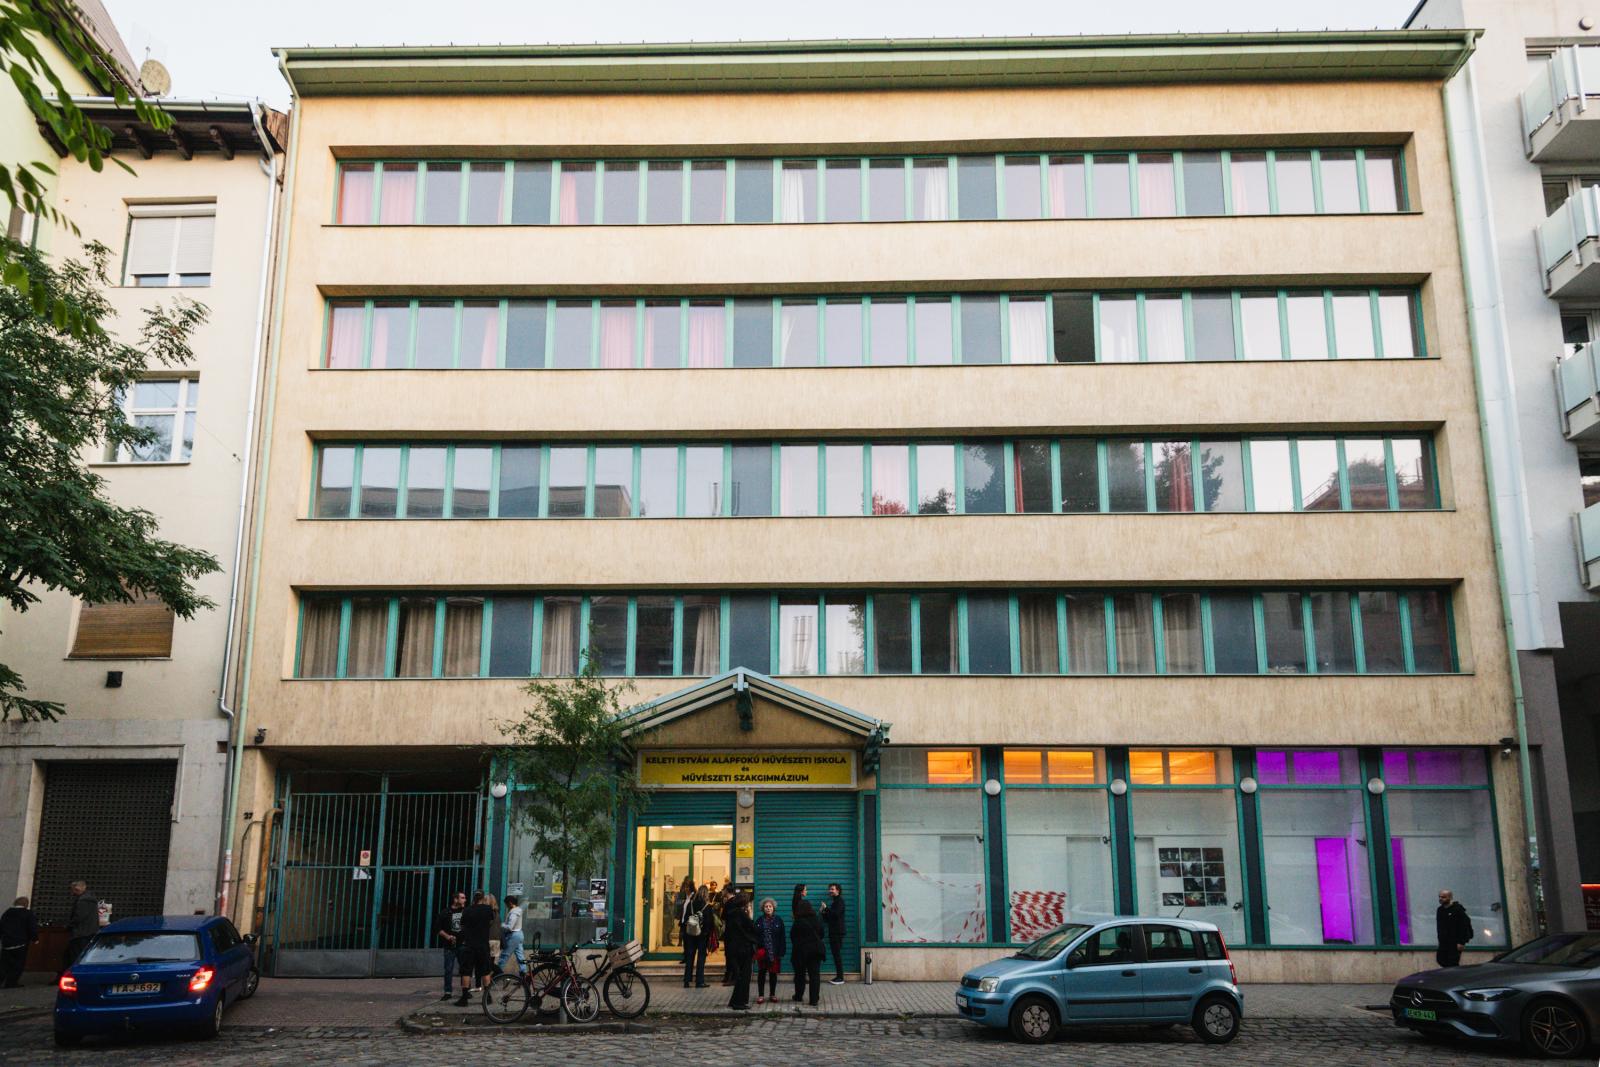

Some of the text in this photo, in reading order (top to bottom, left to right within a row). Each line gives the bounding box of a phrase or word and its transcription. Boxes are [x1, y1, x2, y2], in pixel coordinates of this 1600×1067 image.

[645, 754, 847, 765] KELETI ISTVÁN ALAPFOKÚ MŰVÉSZETI ISKOLA
[681, 772, 809, 782] MŰVÉSZETI SZAKGIMNÁZIUM
